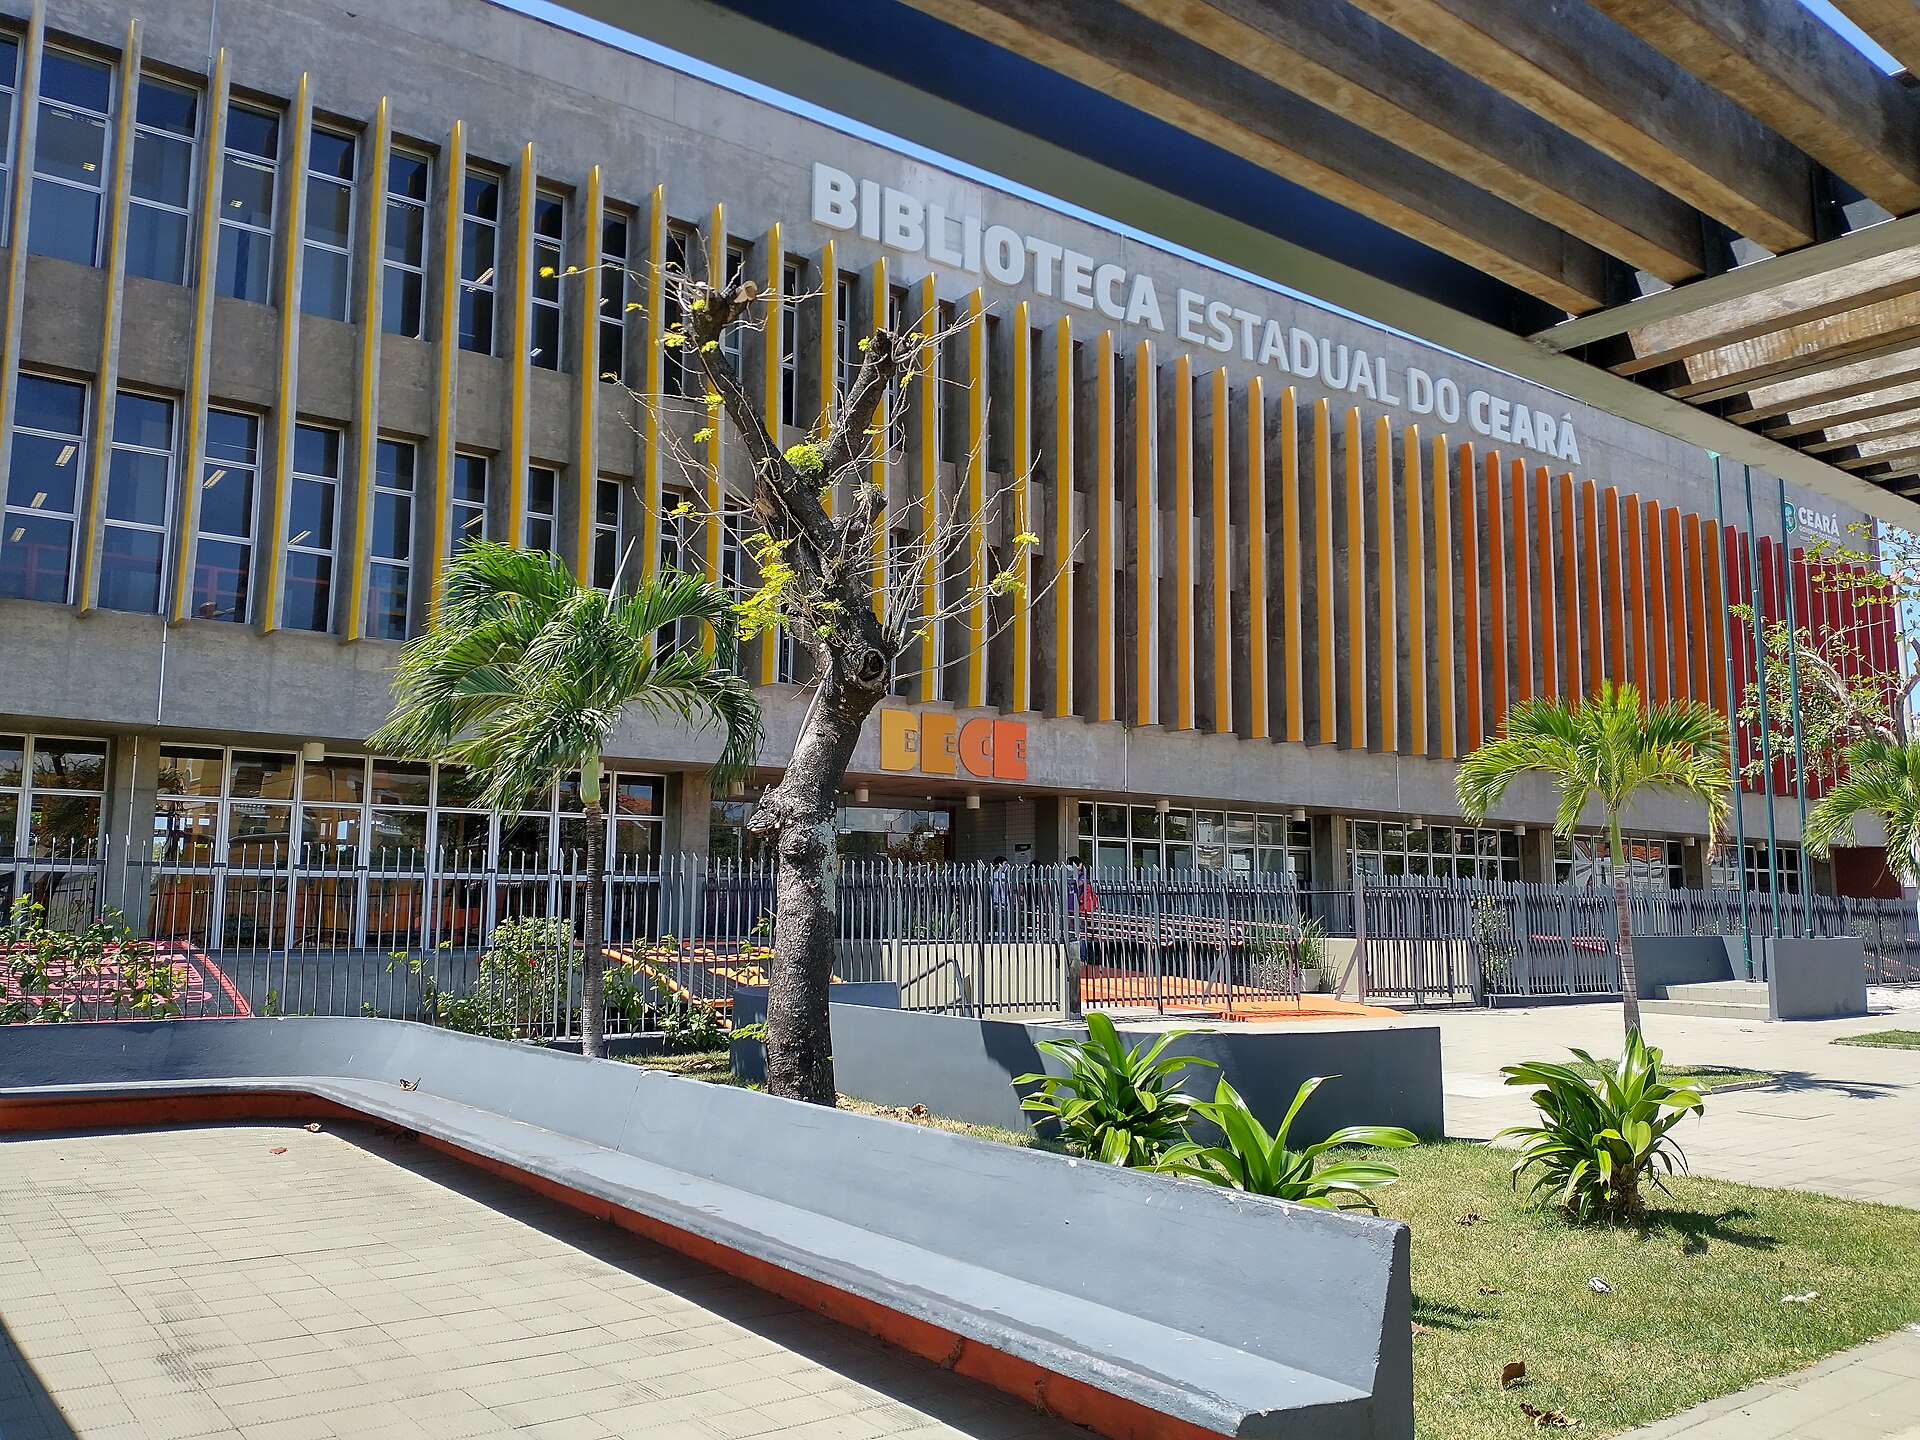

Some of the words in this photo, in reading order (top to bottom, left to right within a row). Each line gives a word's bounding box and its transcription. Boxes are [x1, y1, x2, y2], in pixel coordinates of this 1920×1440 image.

[811, 161, 1165, 332] BIBLIOTECA
[1176, 288, 1400, 406] ESTADUAL
[1406, 367, 1460, 424] DO
[1467, 390, 1582, 465] CEARÁ
[1798, 506, 1840, 537] CEARÁ
[880, 708, 1027, 780] BECE
